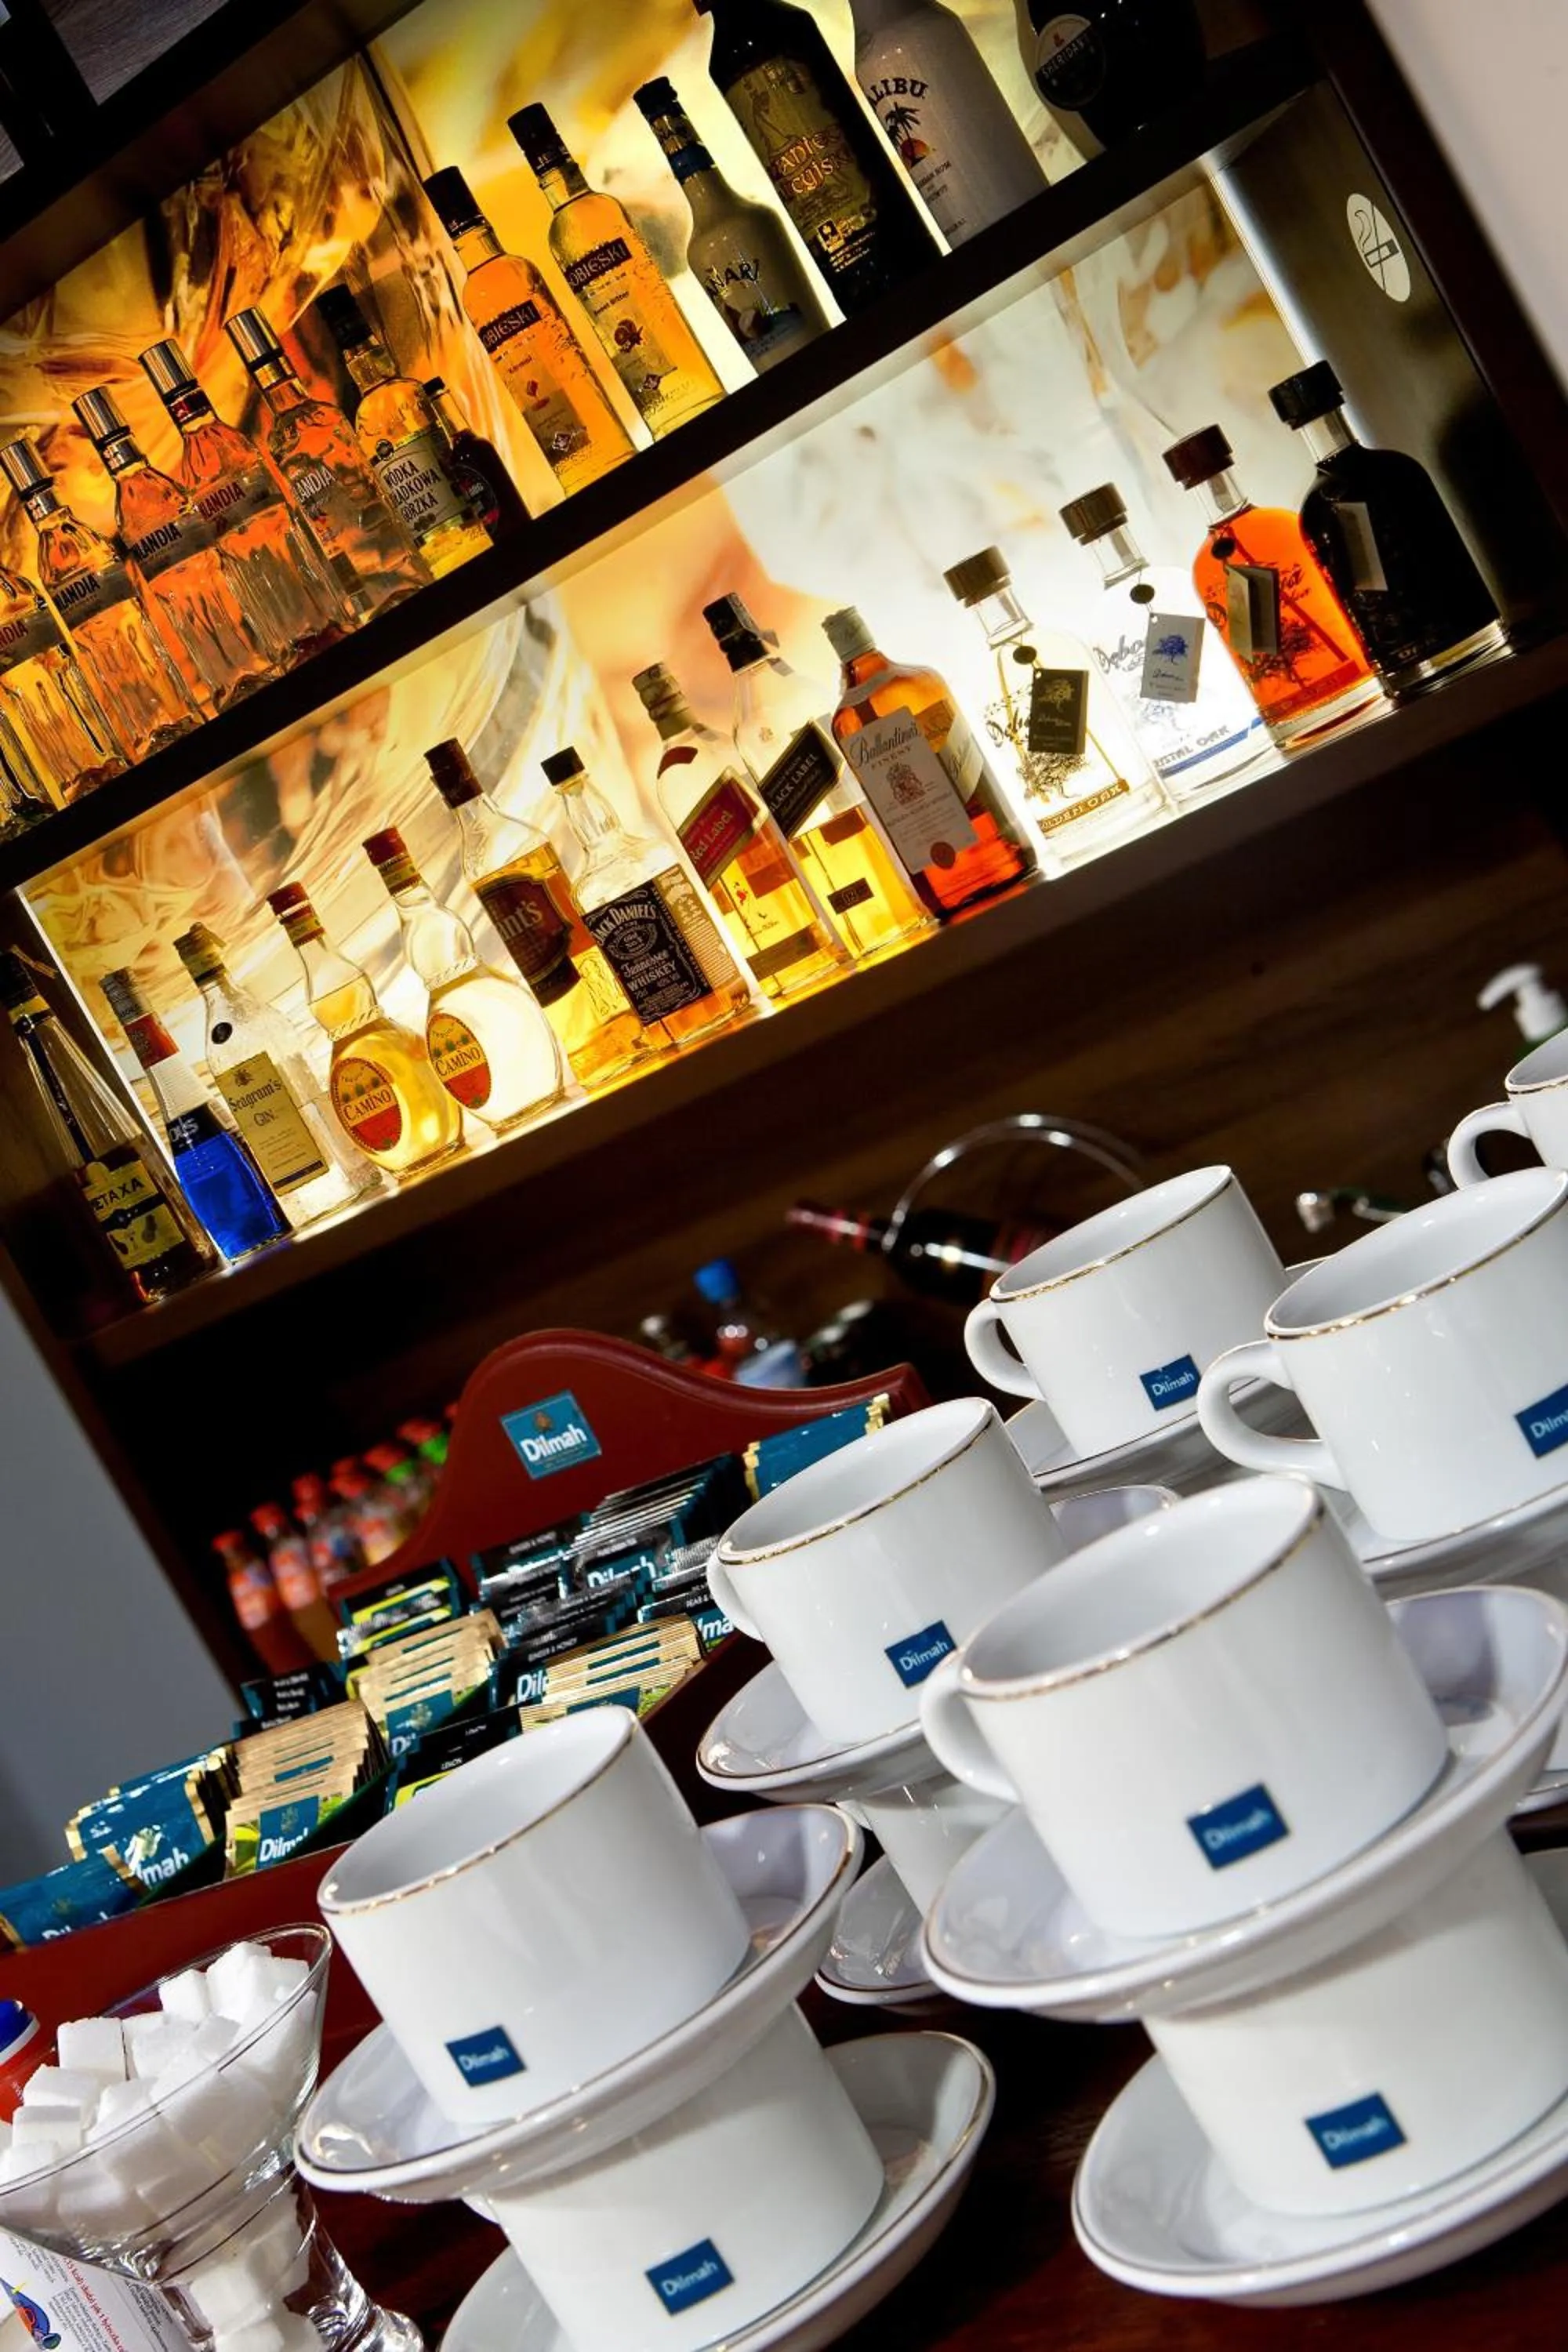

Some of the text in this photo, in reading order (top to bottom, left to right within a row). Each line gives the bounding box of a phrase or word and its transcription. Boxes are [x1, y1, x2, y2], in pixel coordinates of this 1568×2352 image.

[590, 916, 615, 947] JACK
[626, 960, 677, 992] WHISKEY
[1151, 1371, 1196, 1397] Dilmah
[1530, 1410, 1568, 1439] Dilm
[520, 1423, 588, 1462] Dilmah
[697, 1617, 735, 1641] lma
[898, 1641, 949, 1671] Dilmah
[1203, 1806, 1272, 1850] Dilmah
[458, 2045, 510, 2073] Dilmah
[1320, 2115, 1389, 2151] Dilmah
[660, 2260, 719, 2298] Dilmah
